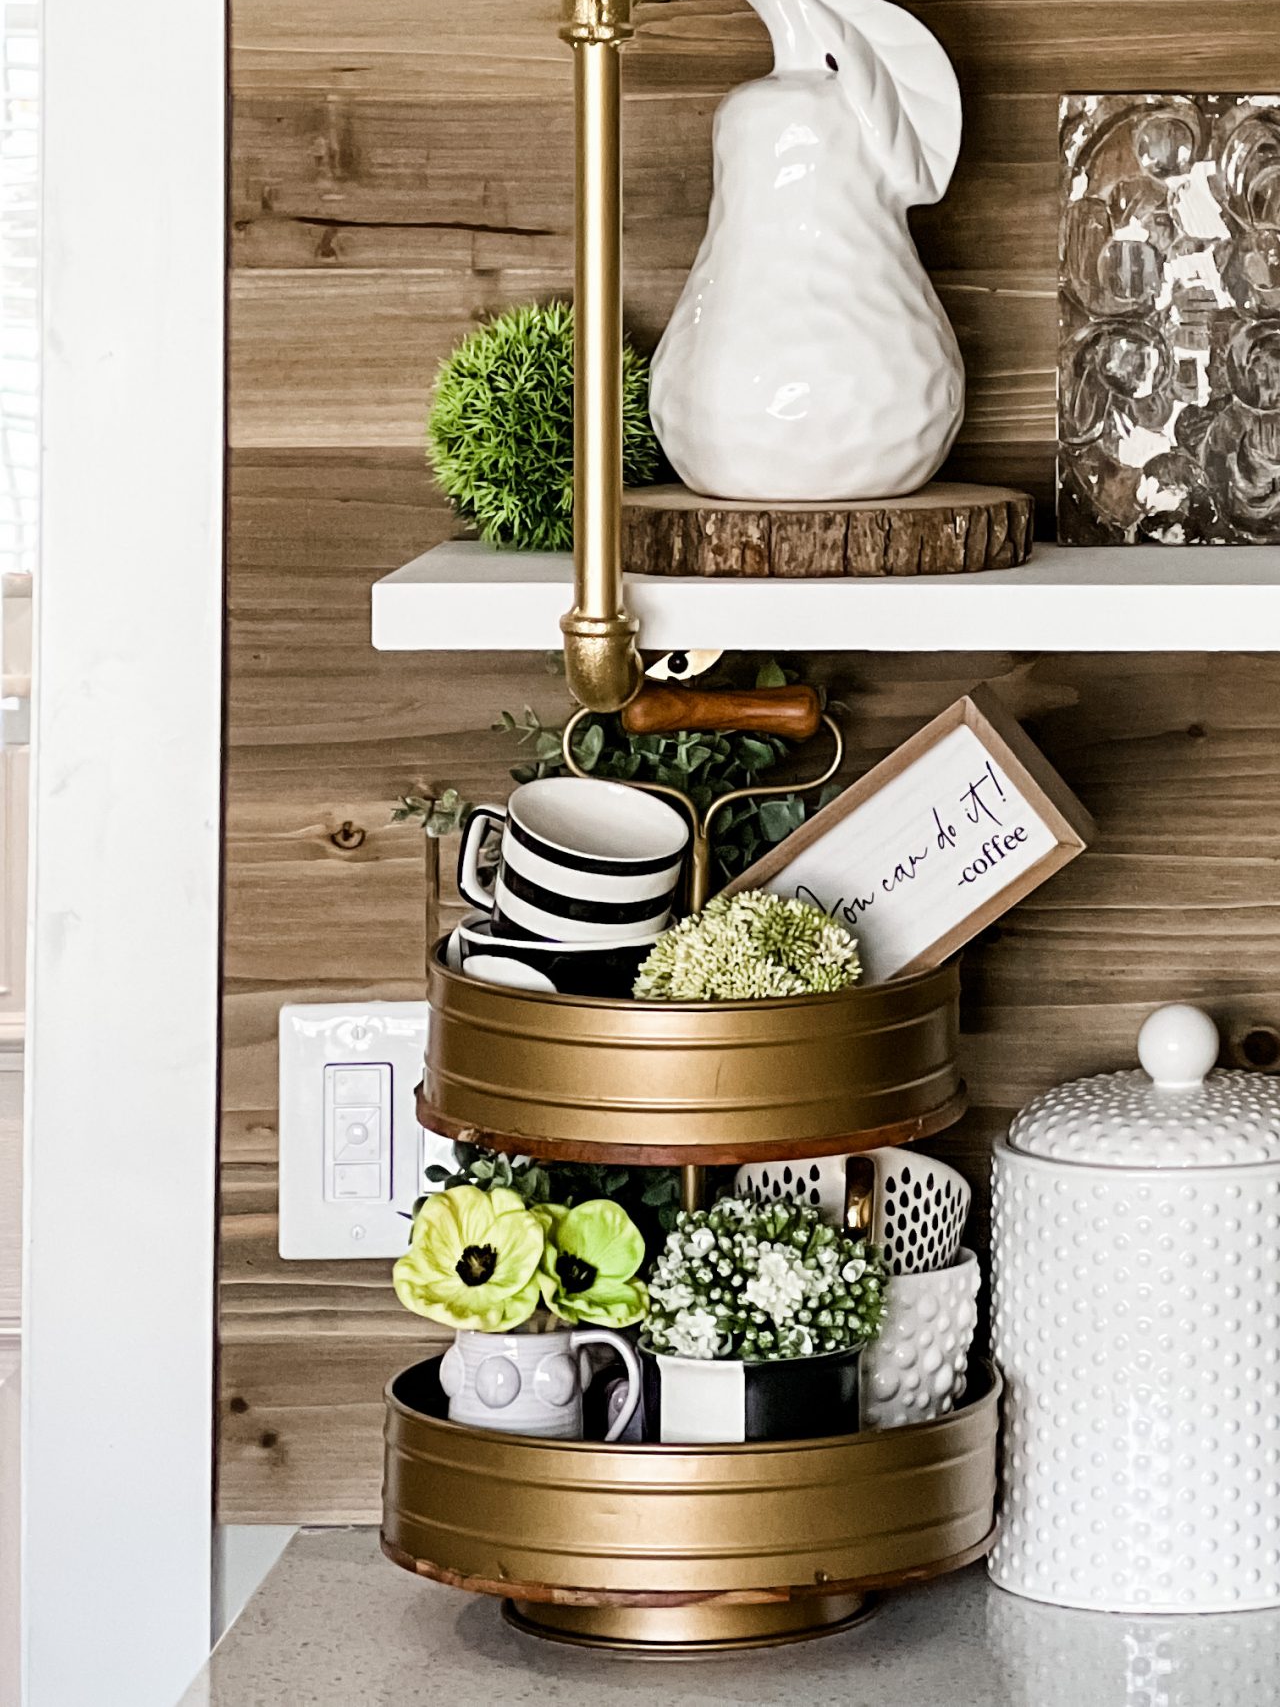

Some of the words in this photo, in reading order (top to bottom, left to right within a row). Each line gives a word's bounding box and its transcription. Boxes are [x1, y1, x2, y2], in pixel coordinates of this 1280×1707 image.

[882, 846, 929, 892] can
[932, 807, 958, 850] do
[959, 760, 1007, 827] it!
[957, 825, 1029, 887] -coffee
